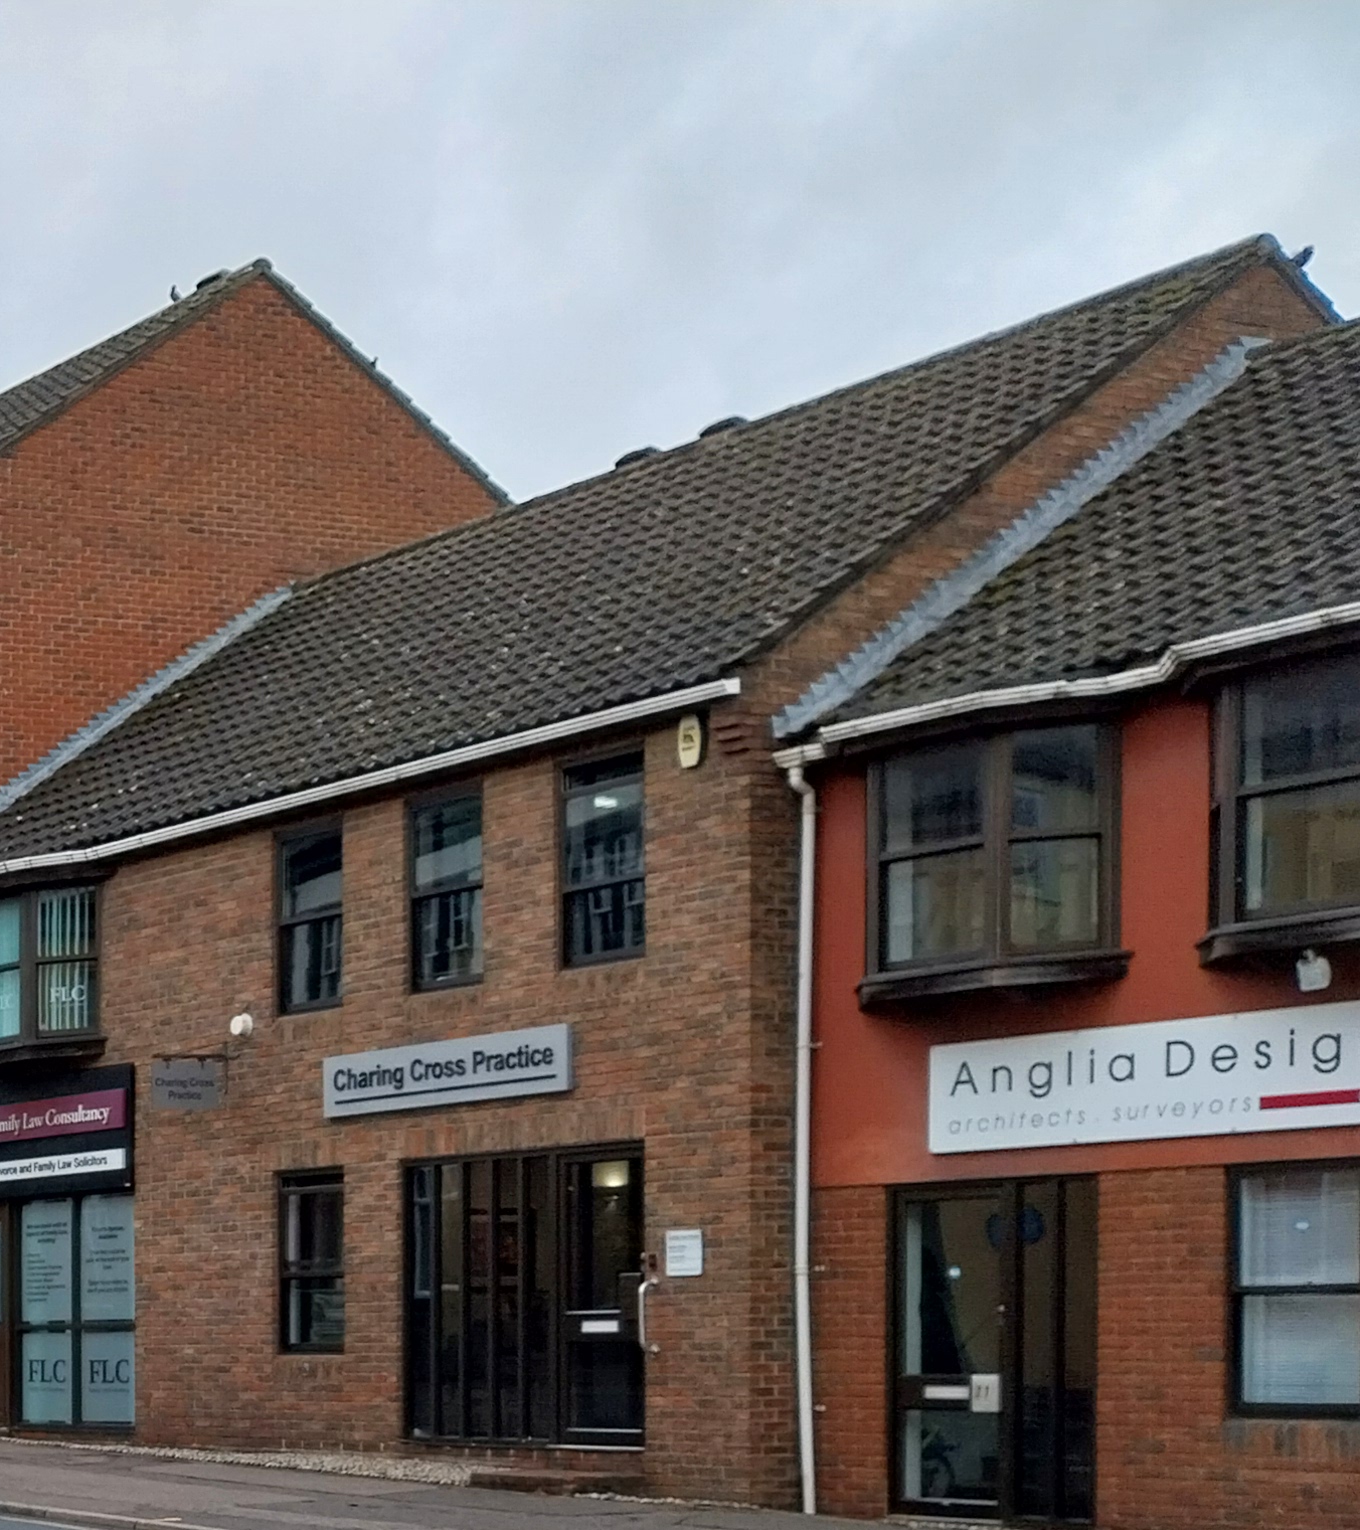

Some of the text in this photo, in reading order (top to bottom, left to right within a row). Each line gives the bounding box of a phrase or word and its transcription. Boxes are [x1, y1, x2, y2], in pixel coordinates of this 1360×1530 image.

[333, 1044, 554, 1091] Charing Cross Practice
[949, 1049, 1136, 1098] Anglia
[23, 1112, 44, 1129] Law
[45, 1104, 111, 1125] Consultancy
[948, 1095, 1253, 1135] architects surveyors
[19, 1164, 31, 1173] and
[33, 1161, 56, 1173] Family
[57, 1160, 71, 1170] Law
[74, 1155, 108, 1168] Solicitors
[28, 1359, 66, 1383] FLC
[89, 1359, 130, 1384] FLC
